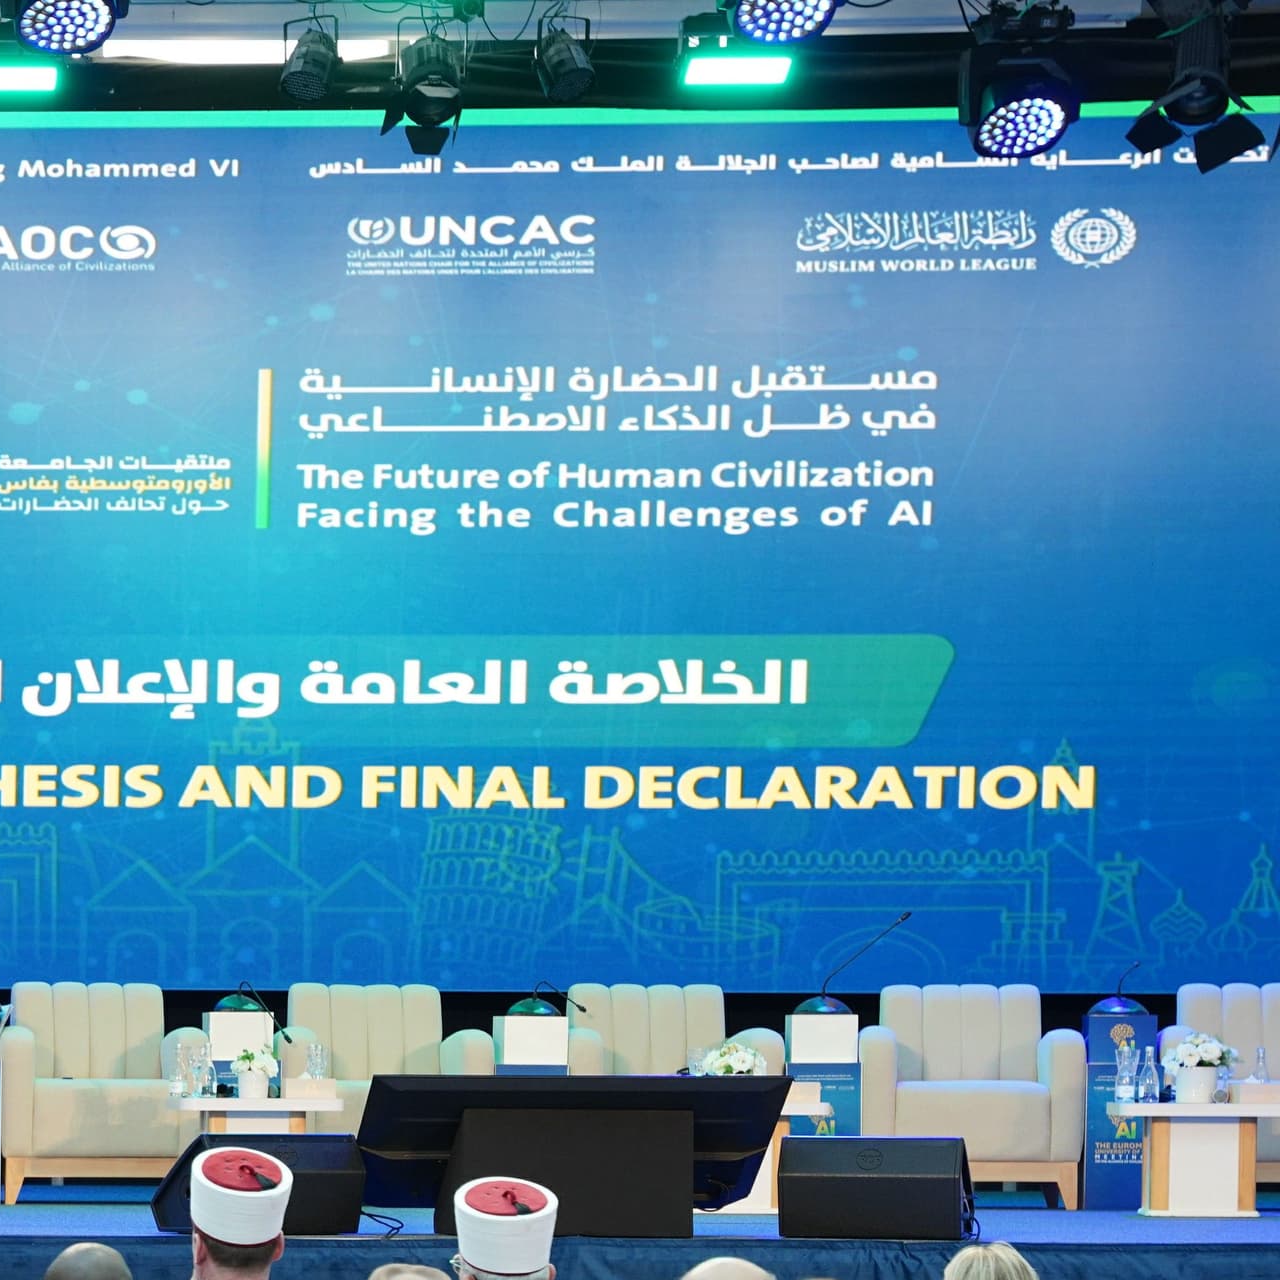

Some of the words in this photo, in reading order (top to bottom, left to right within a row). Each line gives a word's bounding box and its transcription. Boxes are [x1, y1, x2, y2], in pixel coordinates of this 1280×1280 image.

[17, 158, 197, 178] Mohammed
[209, 158, 240, 177] VI
[308, 157, 441, 179] السادس
[452, 157, 561, 175] محمد
[570, 155, 664, 173] الملك
[675, 153, 776, 175] الجلالة
[788, 152, 879, 174] لصاحب
[400, 214, 596, 246] UNCAC
[461, 247, 508, 258] المتحدة
[513, 247, 546, 260] الأمم
[1, 260, 55, 272] Alliance
[58, 260, 72, 272] of
[75, 260, 155, 272] Civilizations
[796, 260, 875, 273] MUSLIM
[881, 259, 954, 272] WORLD
[960, 258, 1037, 272] LEAGUE
[298, 366, 556, 402] الإنسانية
[567, 366, 718, 401] الحضارة
[730, 366, 938, 398] مستقبل
[298, 405, 605, 441] الاصطناعي
[618, 403, 731, 432] الذكاء
[742, 404, 851, 438] ظل
[862, 403, 937, 437] في
[118, 455, 231, 473] ملتقيات
[296, 463, 364, 490] The
[372, 463, 499, 490] Future
[507, 462, 543, 490] of
[558, 462, 702, 489] Human
[710, 460, 934, 488] Civilization
[65, 472, 231, 494] الأورومتوسطية
[106, 496, 167, 512] تحالف
[171, 497, 230, 515] حول
[296, 501, 436, 537] Facing
[456, 501, 531, 528] the
[552, 499, 799, 536] Challenges
[828, 498, 868, 527] of
[887, 501, 933, 527] AI
[22, 657, 282, 719] والإعلان
[299, 658, 528, 705] العامة
[549, 658, 808, 705] الخلاصة
[178, 765, 343, 810] AND
[361, 765, 566, 810] FINAL
[584, 765, 1096, 811] DECLARATION
[815, 1119, 836, 1136] AI
[1115, 1121, 1137, 1140] AI
